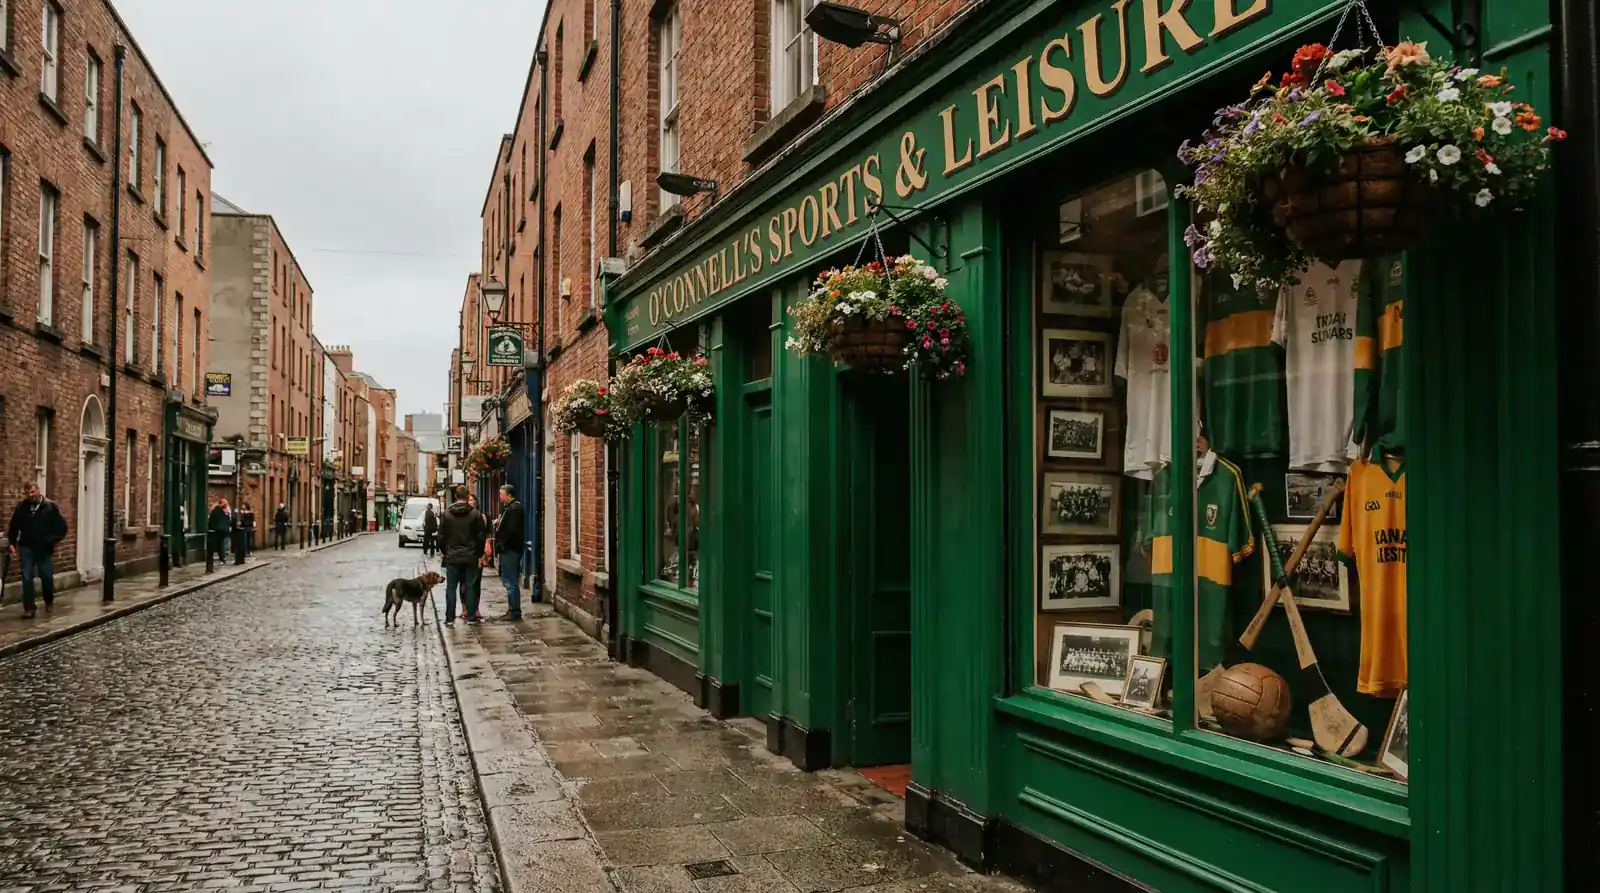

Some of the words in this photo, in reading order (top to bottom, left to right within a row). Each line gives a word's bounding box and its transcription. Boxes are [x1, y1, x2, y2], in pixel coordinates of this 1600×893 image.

[649, 225, 763, 327] O'CONNELL'S
[769, 152, 884, 264] SPORTS
[895, 131, 928, 198] &
